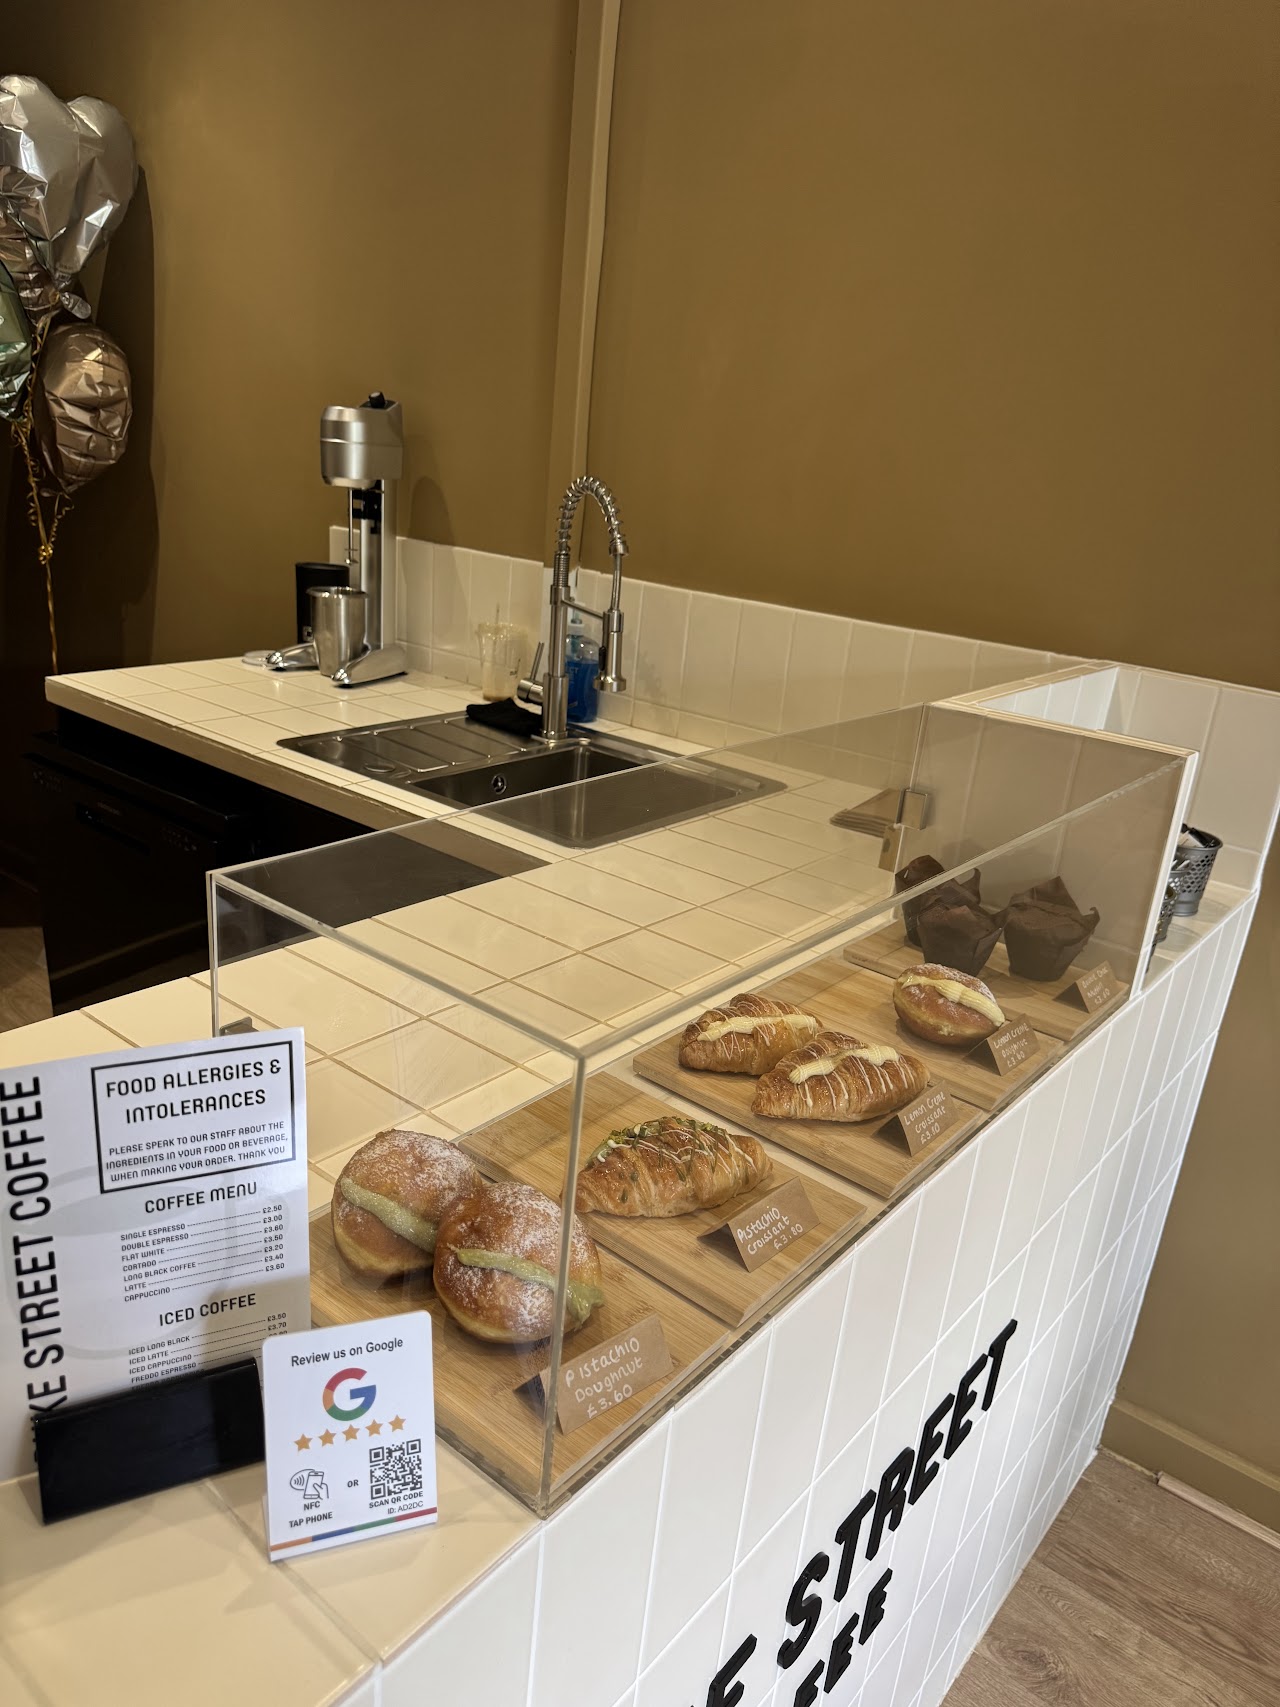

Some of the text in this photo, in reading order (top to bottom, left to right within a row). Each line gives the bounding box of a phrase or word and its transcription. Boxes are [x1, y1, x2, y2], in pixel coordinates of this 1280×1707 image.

[106, 1059, 282, 1098] FOOD ALLERGIES &
[125, 1089, 266, 1124] INTOLERANCES
[903, 1104, 927, 1126] Lemon
[0, 1076, 51, 1221] COFFEE
[106, 1133, 289, 1170] INGREDIENTS IN YOUR FOOD OR BEVERAGE,
[109, 1121, 285, 1156] PLEASE SPEAK TO OUR STAFF ABOUT THE
[110, 1145, 286, 1182] WHEN MAKING YOUR ORDER. THANK YOU
[145, 1181, 258, 1214] COFFEE MENU
[120, 1204, 283, 1242] SINGLE ESPRESSO £2.50
[121, 1214, 283, 1252] DOUBLE ESPRESSO £3.00
[773, 1223, 804, 1250] £3.80
[121, 1252, 139, 1262] FLAT
[141, 1247, 166, 1259] WHITE
[122, 1260, 157, 1273] CORTADO
[123, 1243, 284, 1282] LONG BLACK COFFEE £3.20
[12, 1234, 64, 1370] STREET
[124, 1281, 147, 1292] LATTE
[124, 1287, 171, 1302] CAPPUCCINO
[159, 1293, 257, 1326] ICED COFFEE
[128, 1345, 146, 1355] ICED
[146, 1340, 166, 1351] LONG
[167, 1335, 191, 1347] BLACK
[129, 1322, 287, 1365] ICED LATTE £3.70
[291, 1338, 403, 1367] Review us on Google
[129, 1353, 192, 1375] ICED CAPPUCCINO
[131, 1362, 197, 1383] FREDDO ESPRESSO
[574, 1356, 643, 1403] Doughnut
[586, 1384, 633, 1418] £3.60
[347, 1479, 359, 1488] OR
[368, 1490, 424, 1509] SCAN QR CODE
[777, 1318, 1018, 1670] STREET
[289, 1511, 333, 1528] TAP PHONE
[303, 1500, 321, 1511] NFC
[387, 1501, 424, 1515] ID: AD2DC
